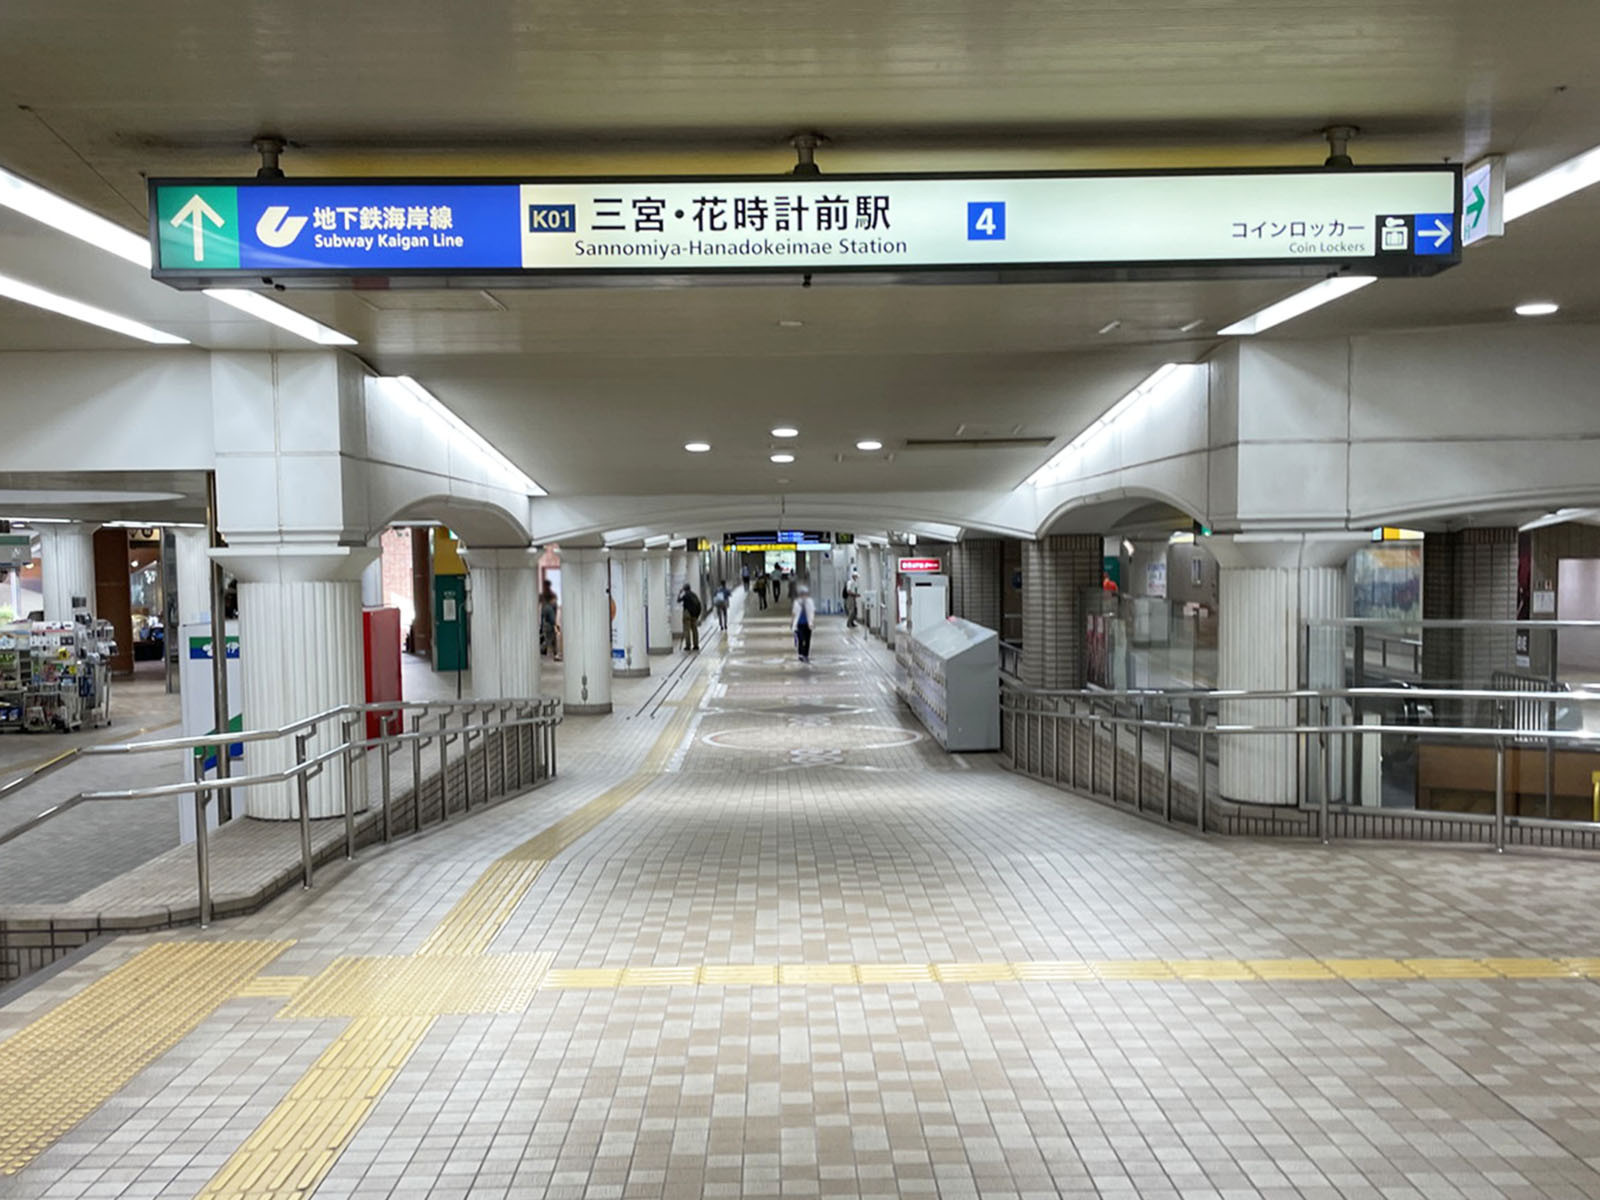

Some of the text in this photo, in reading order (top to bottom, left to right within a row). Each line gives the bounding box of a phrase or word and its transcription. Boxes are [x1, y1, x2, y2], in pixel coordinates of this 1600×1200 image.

[313, 206, 453, 231] 地下鉄海岸線
[532, 209, 571, 229] K01
[591, 194, 892, 232] 三宮・花時計前駅
[975, 207, 996, 236] 4
[1231, 219, 1365, 239] コインロッカー
[314, 233, 464, 251] Subway Kaigan Line
[575, 237, 907, 260] Sannomiya-Hanadokeimae Station
[1289, 241, 1366, 254] Coin Lockers
